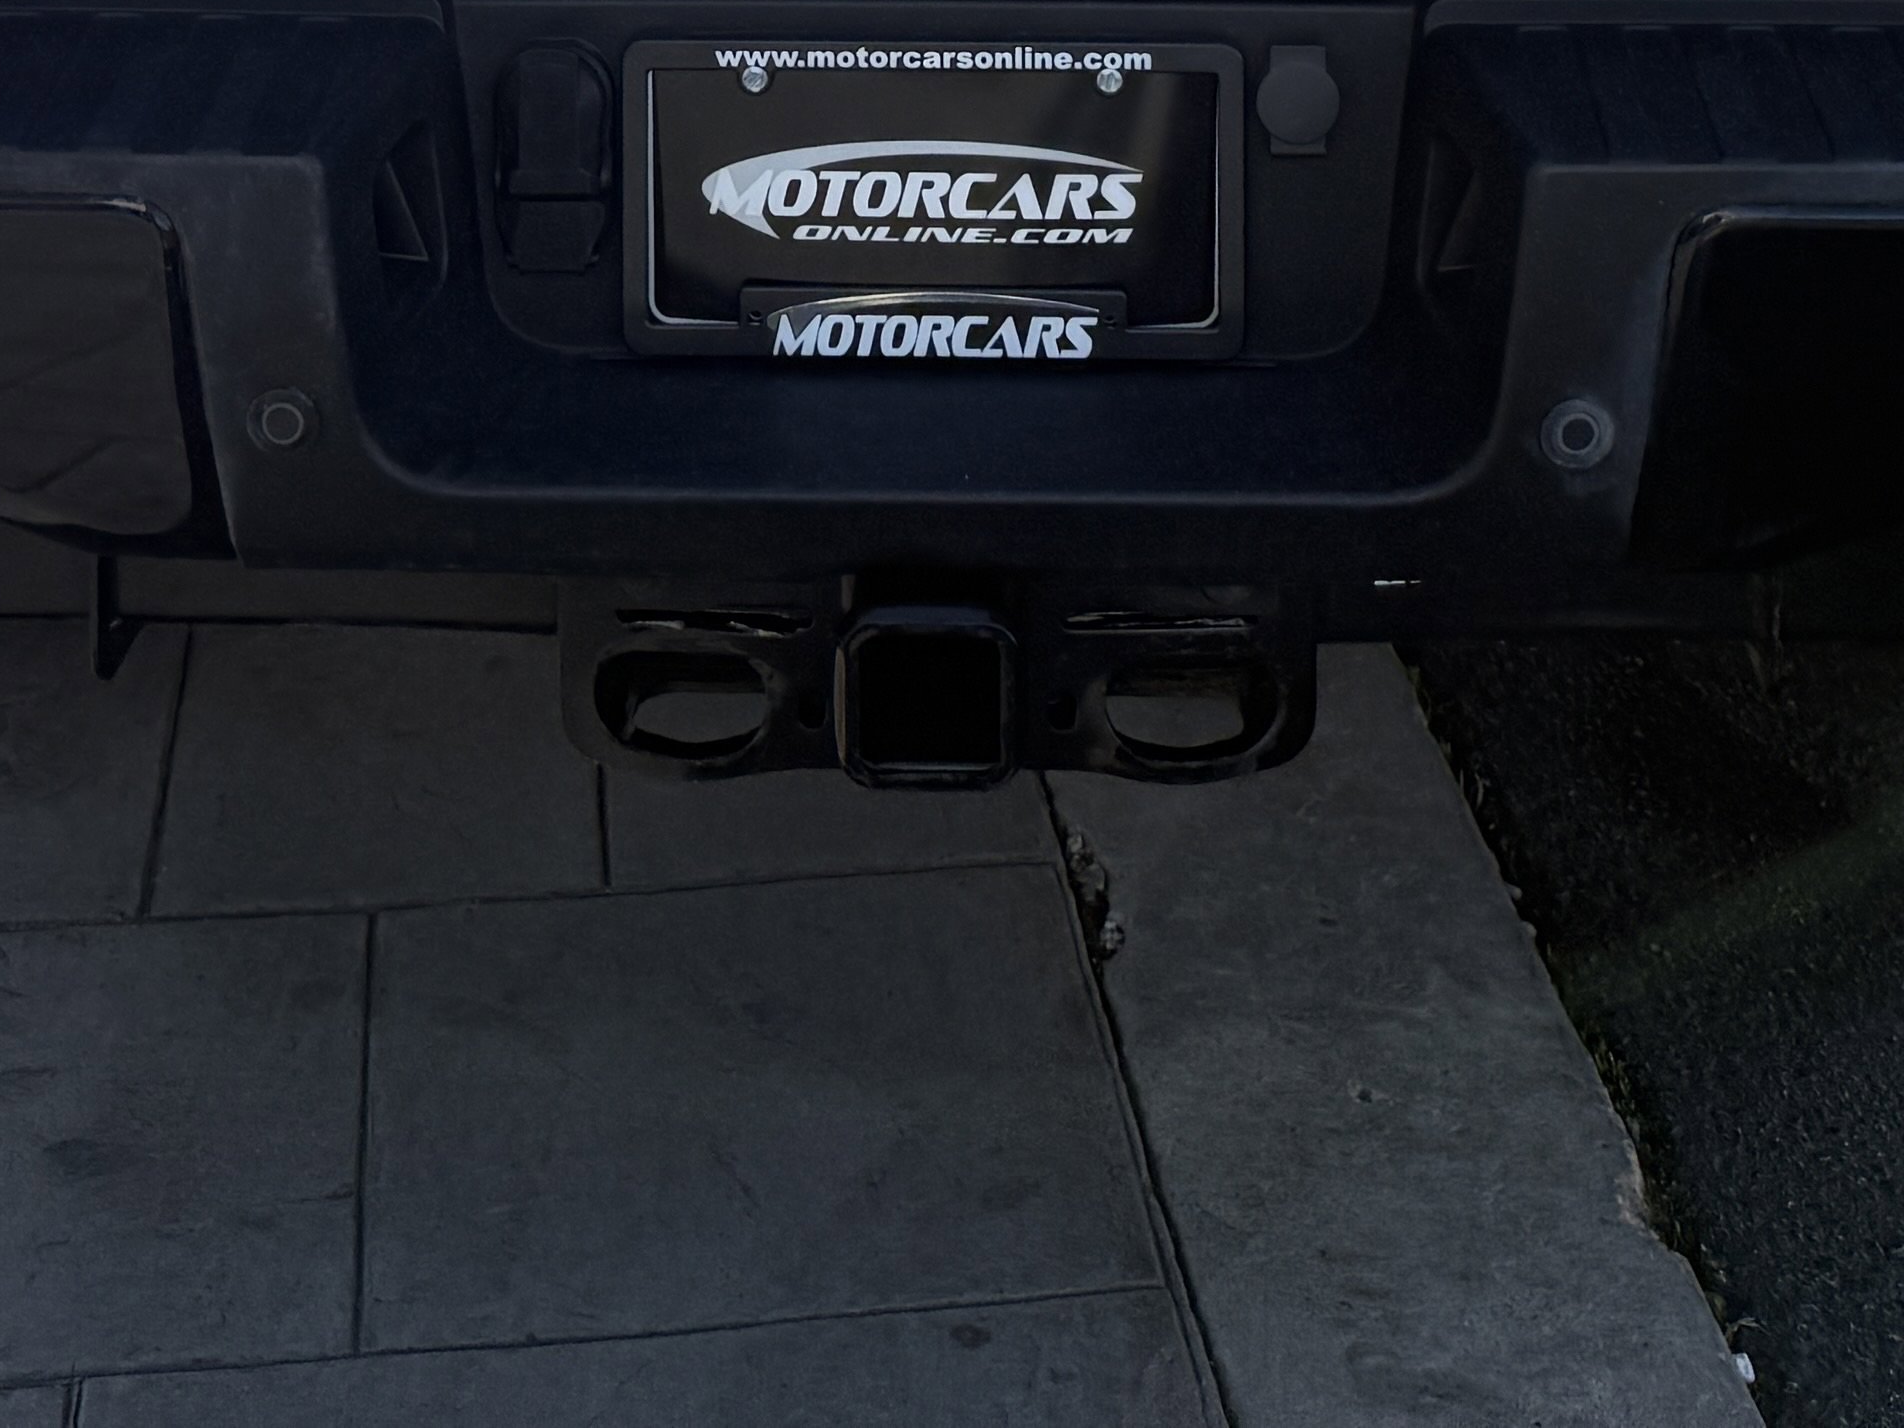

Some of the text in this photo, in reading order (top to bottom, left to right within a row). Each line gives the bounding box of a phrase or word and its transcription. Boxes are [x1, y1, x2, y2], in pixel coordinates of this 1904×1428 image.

[715, 47, 1152, 70] www.motorcarsonline.com
[709, 168, 1144, 221] MOTORCARS
[792, 224, 1134, 244] ONLINE.COM
[773, 314, 1099, 359] MOTORCARS
